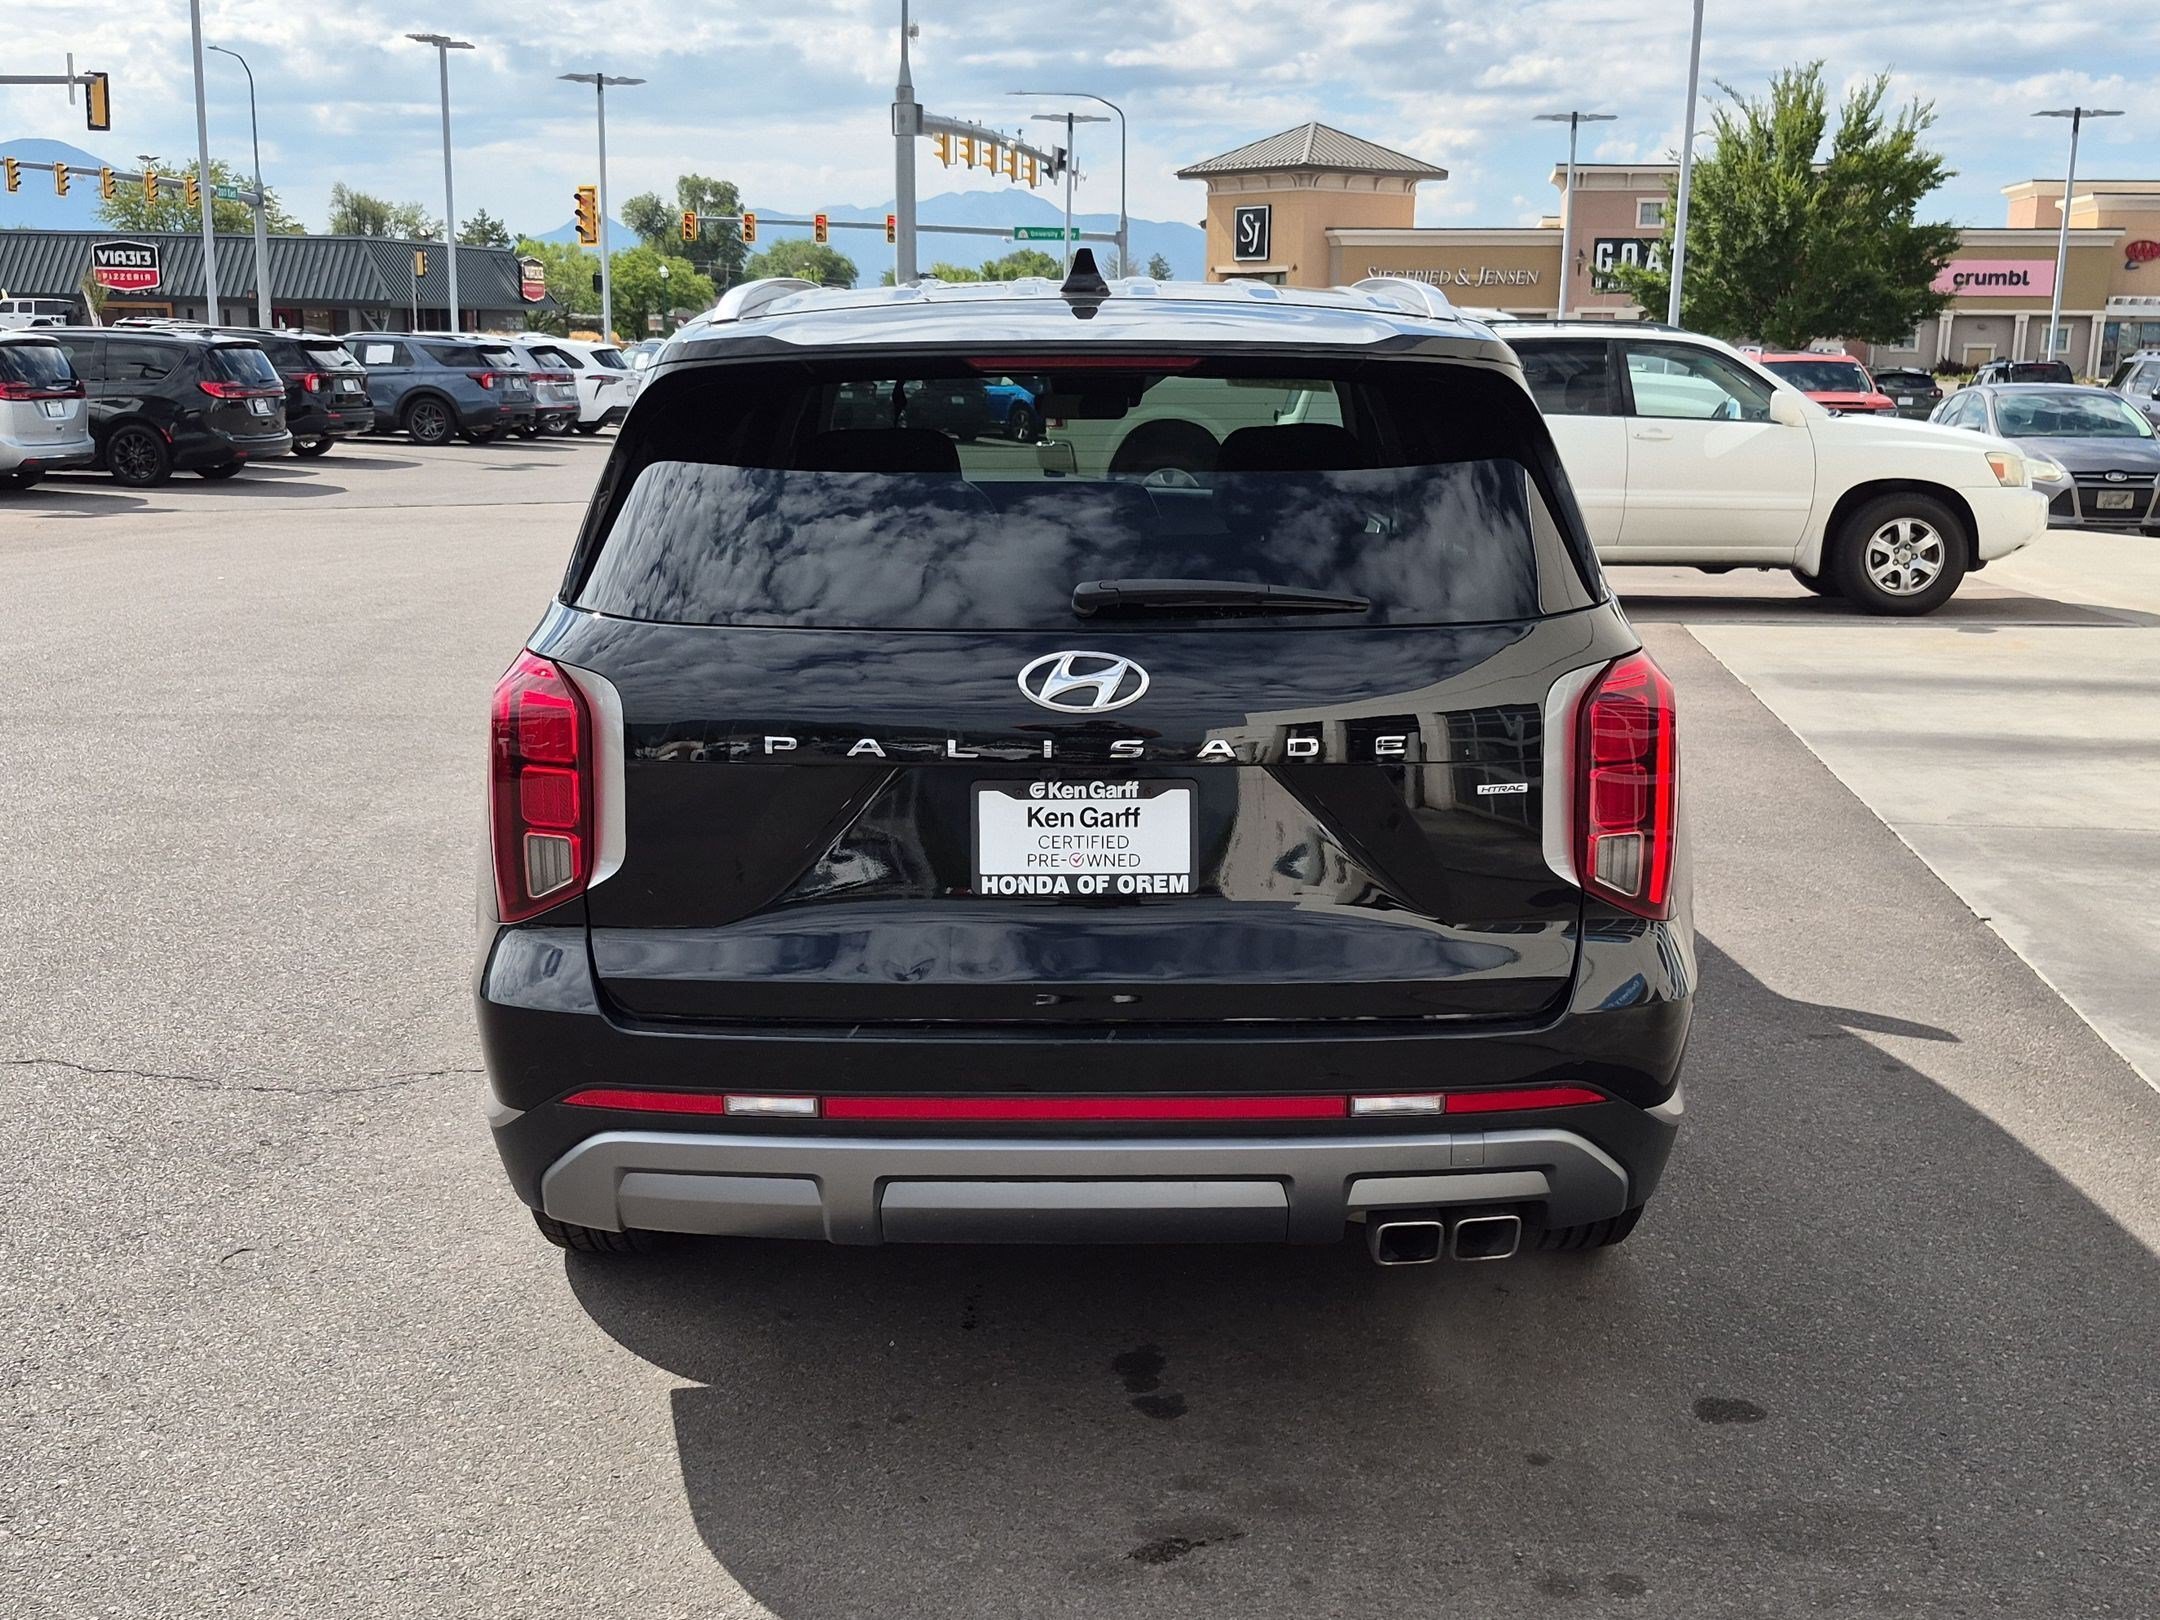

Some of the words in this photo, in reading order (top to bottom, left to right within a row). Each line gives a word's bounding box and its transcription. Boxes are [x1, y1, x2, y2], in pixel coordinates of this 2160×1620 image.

[1596, 242, 1674, 273] GOA
[1455, 267, 1471, 285] &
[1475, 266, 1540, 287] JENSEN
[1952, 270, 2030, 286] crumbl
[764, 735, 1406, 757] PALISADE
[1048, 781, 1087, 799] Ken
[1089, 780, 1140, 799] Garff
[1480, 784, 1525, 793] HTRAC
[1027, 807, 1074, 828] Ken
[1079, 806, 1141, 828] Garff
[1038, 835, 1130, 849] CERTIFIED
[1027, 853, 1141, 868] PRE-OWNED
[981, 875, 1070, 895] HONDA
[1077, 875, 1110, 895] OF
[1117, 875, 1189, 895] OREM
